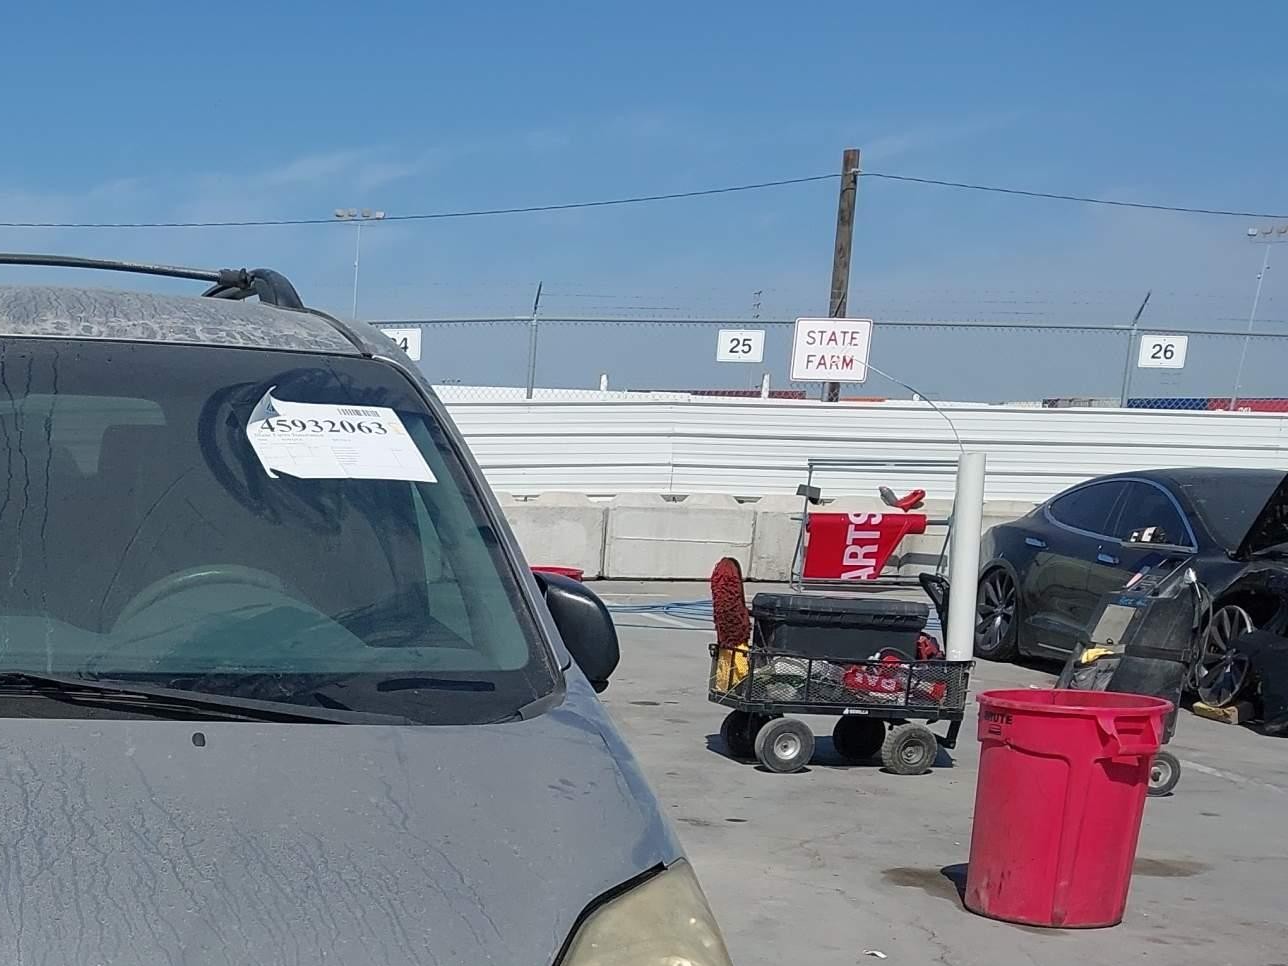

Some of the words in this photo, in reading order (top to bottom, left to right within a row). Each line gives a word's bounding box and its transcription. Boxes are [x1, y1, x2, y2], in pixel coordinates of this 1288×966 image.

[391, 337, 409, 353] 4
[729, 337, 752, 354] 25
[805, 330, 860, 346] STATE
[1150, 343, 1175, 360] 26
[805, 354, 854, 370] FARM
[260, 418, 388, 435] 45932063
